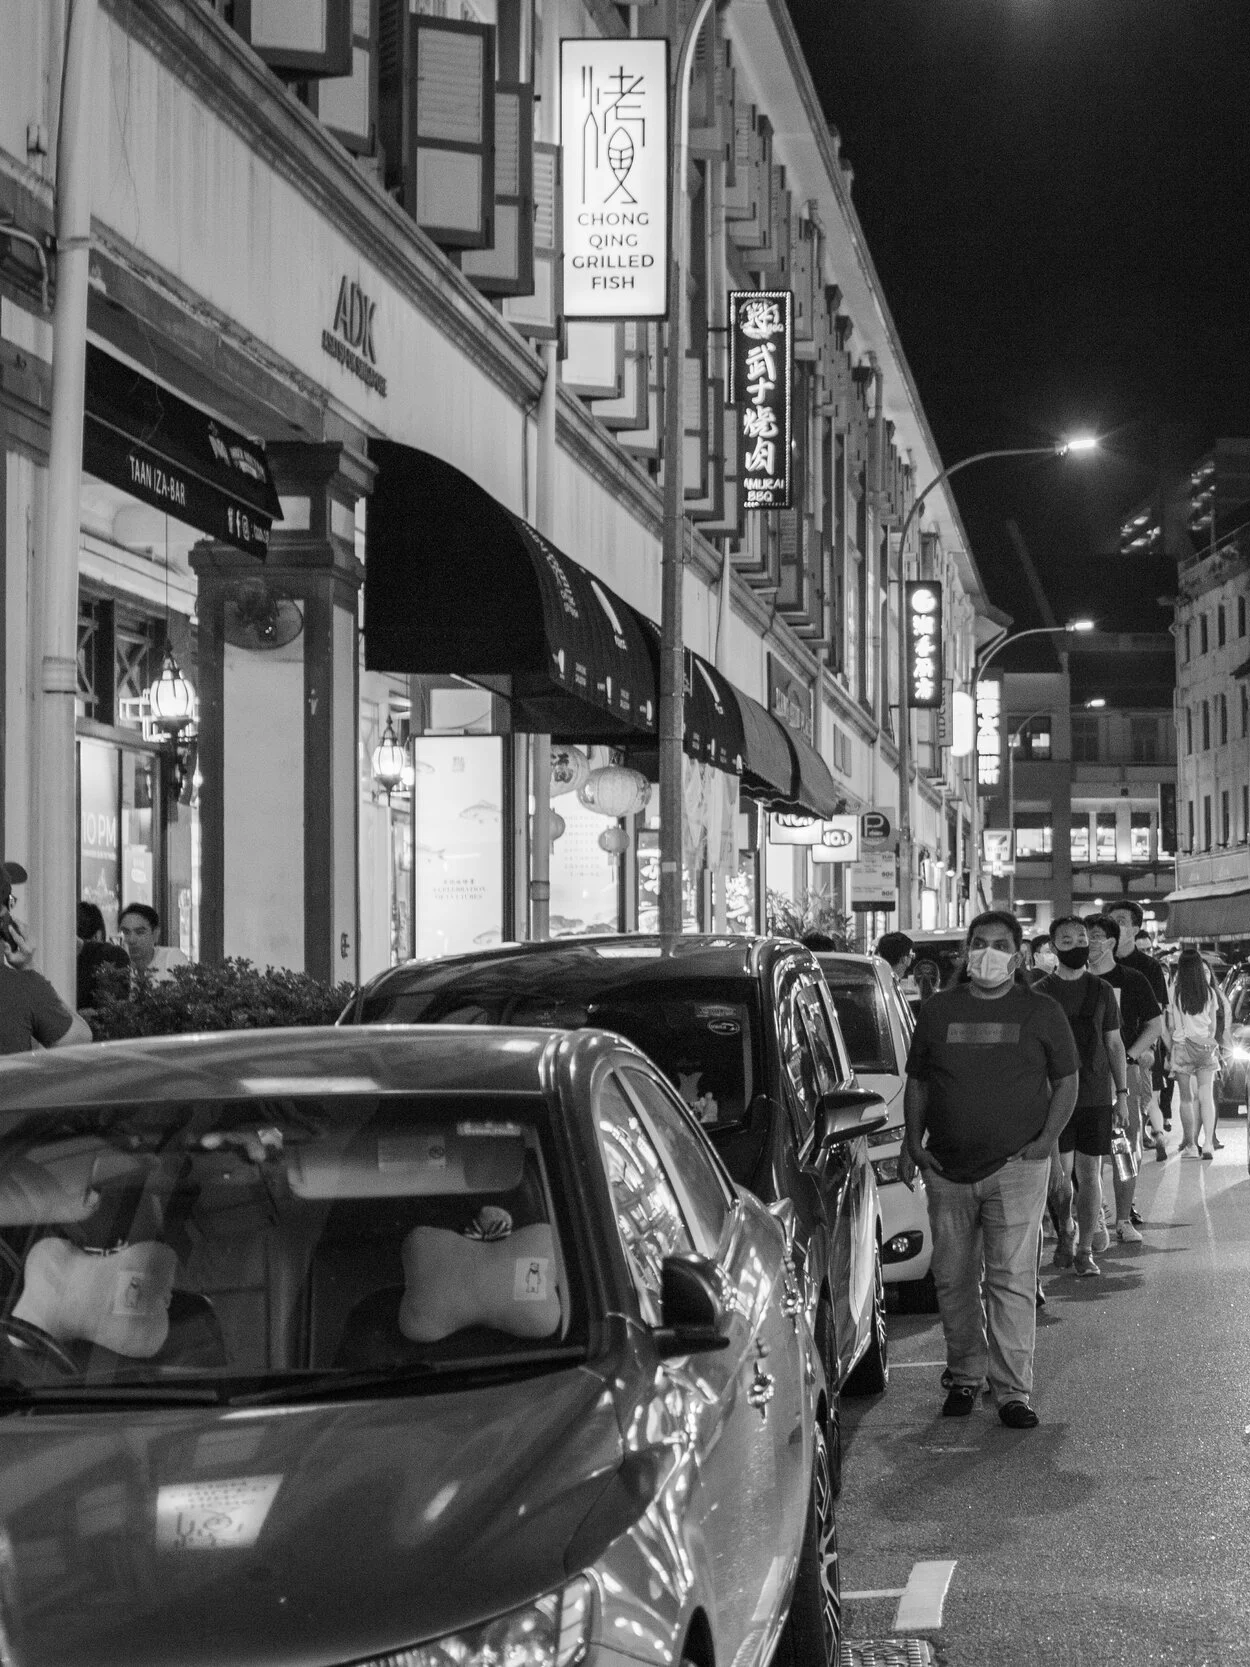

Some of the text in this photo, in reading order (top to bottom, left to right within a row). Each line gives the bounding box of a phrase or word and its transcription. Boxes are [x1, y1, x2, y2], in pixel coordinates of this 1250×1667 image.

[577, 212, 650, 226] CHONG
[589, 234, 638, 249] QING
[572, 255, 655, 269] GRILLED
[591, 276, 635, 290] FISH
[333, 275, 376, 364] ADK
[129, 455, 151, 489] TAAN
[747, 491, 773, 502] BBQ
[98, 814, 117, 849] PM
